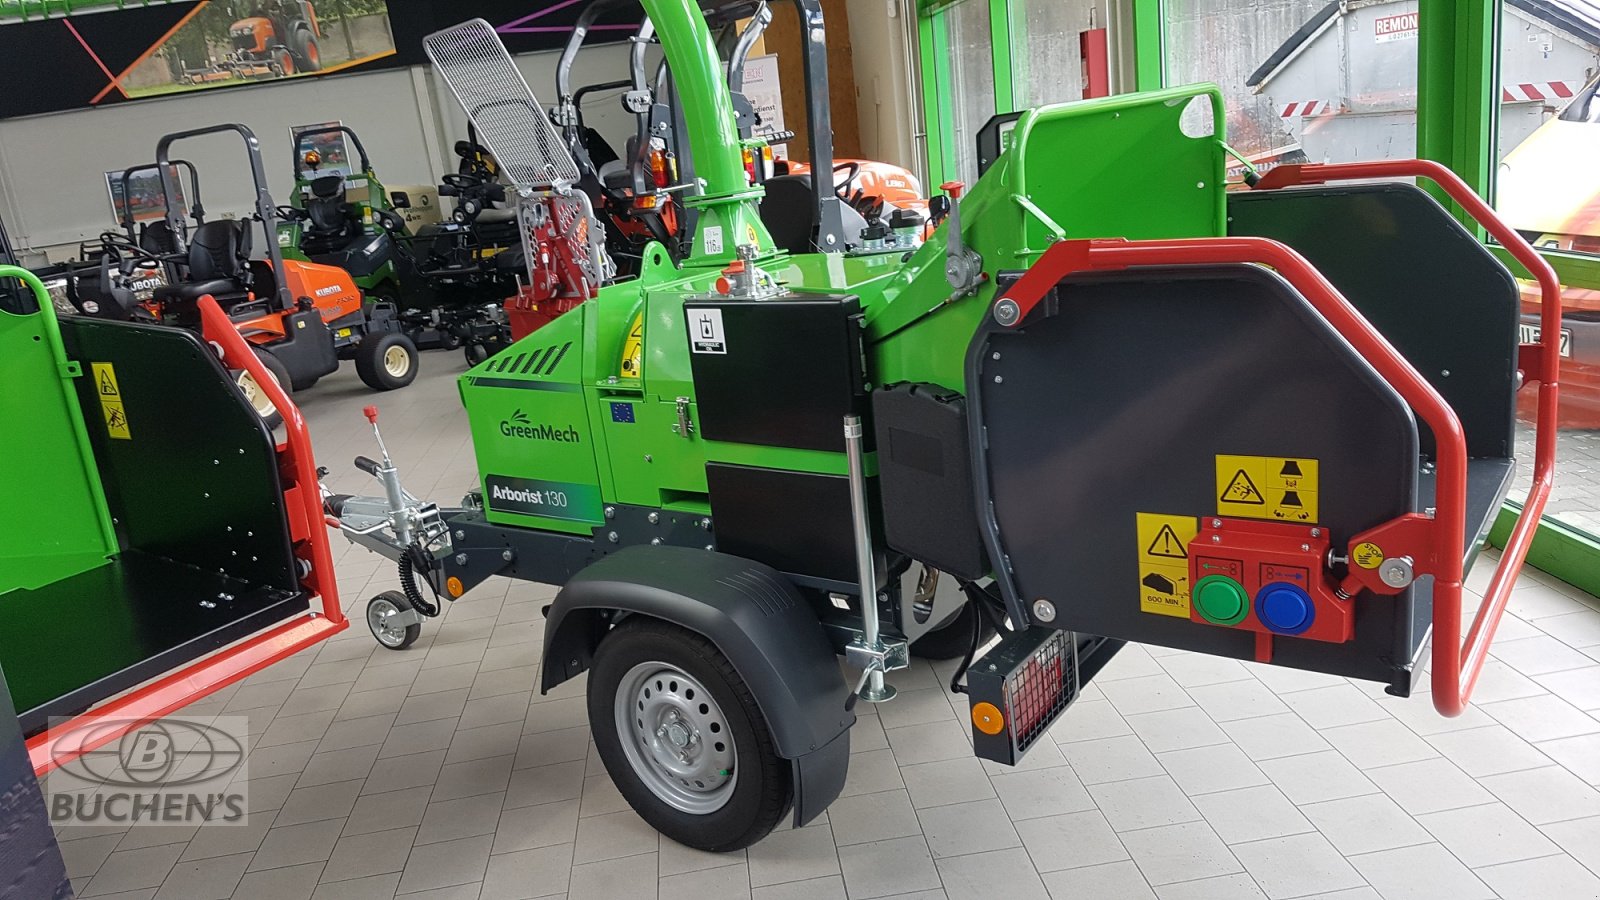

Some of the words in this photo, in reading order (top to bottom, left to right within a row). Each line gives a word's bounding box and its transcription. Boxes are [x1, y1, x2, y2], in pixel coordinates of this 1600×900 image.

[1376, 14, 1418, 34] REMON
[753, 105, 776, 113] rdienst
[706, 239, 717, 252] 116
[131, 278, 161, 292] UBOTA
[315, 285, 342, 297] KUBOTA
[500, 420, 580, 443] GreenMech
[493, 485, 544, 505] Arborist
[544, 490, 567, 508] 130
[1364, 543, 1382, 558] STOP
[1147, 595, 1162, 603] 600
